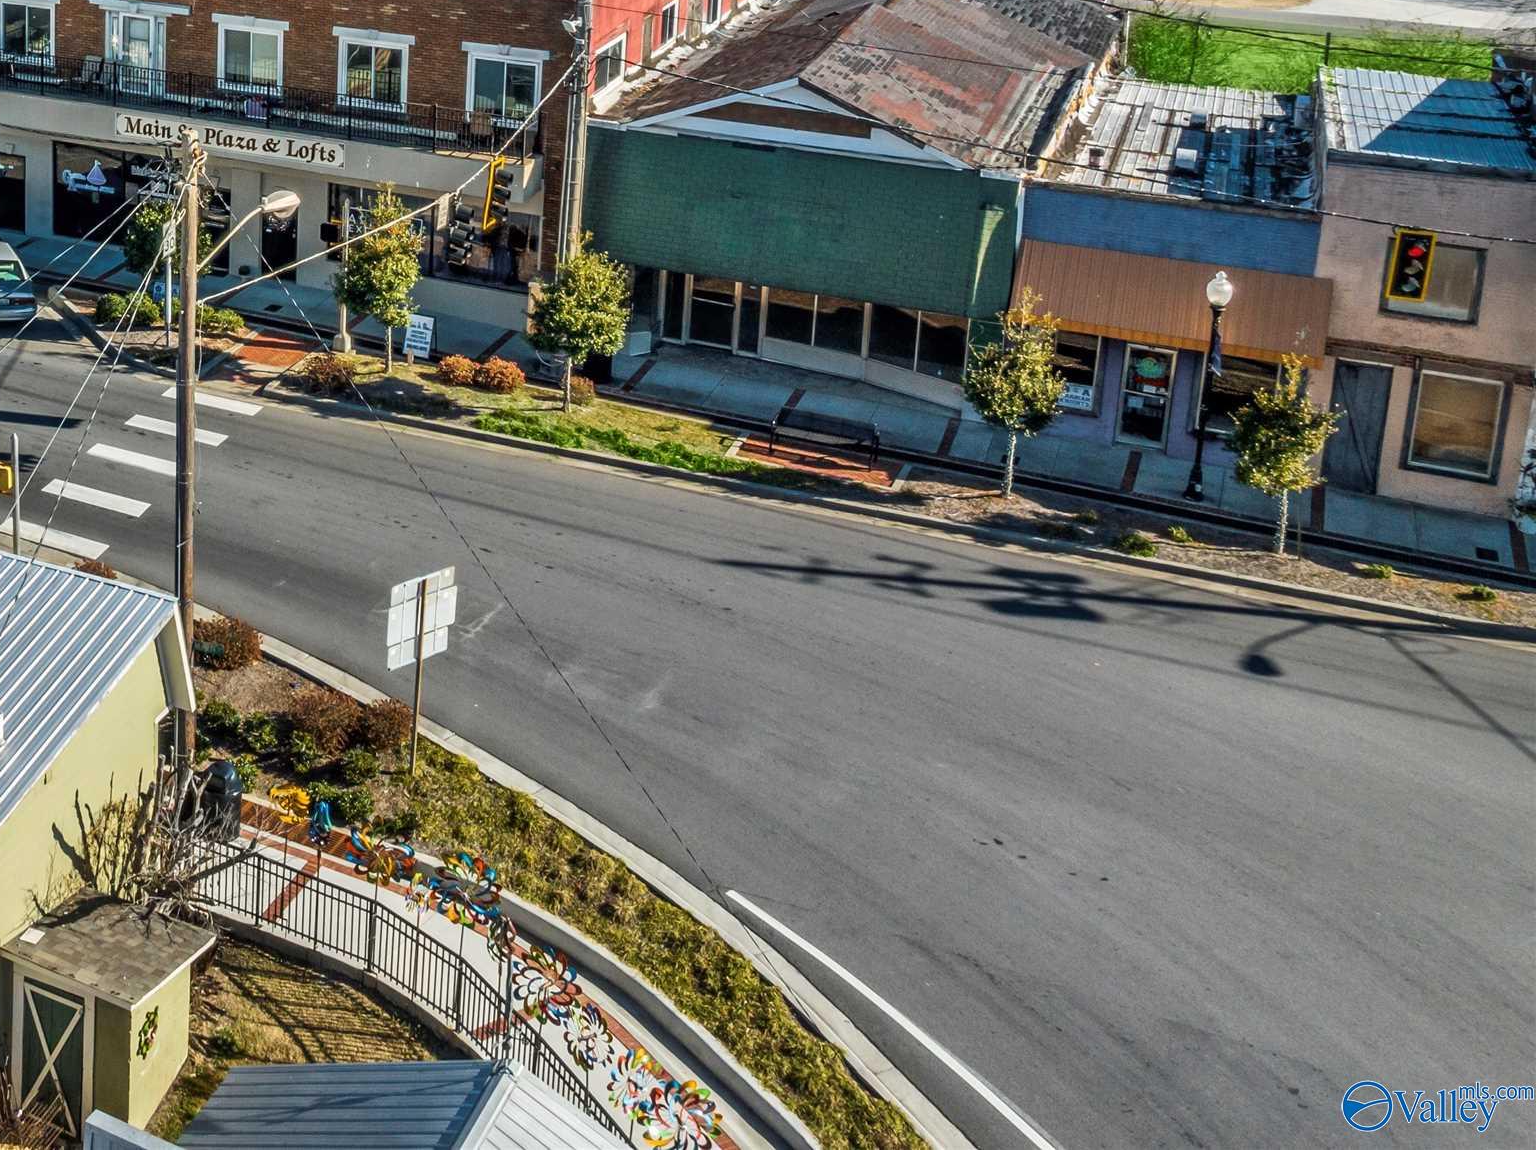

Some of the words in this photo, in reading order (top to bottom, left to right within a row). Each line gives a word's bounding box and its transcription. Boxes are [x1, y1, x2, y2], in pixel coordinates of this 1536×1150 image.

[124, 116, 173, 139] Main
[203, 127, 258, 151] Plaza
[262, 137, 281, 153] &
[286, 139, 336, 163] Lofts
